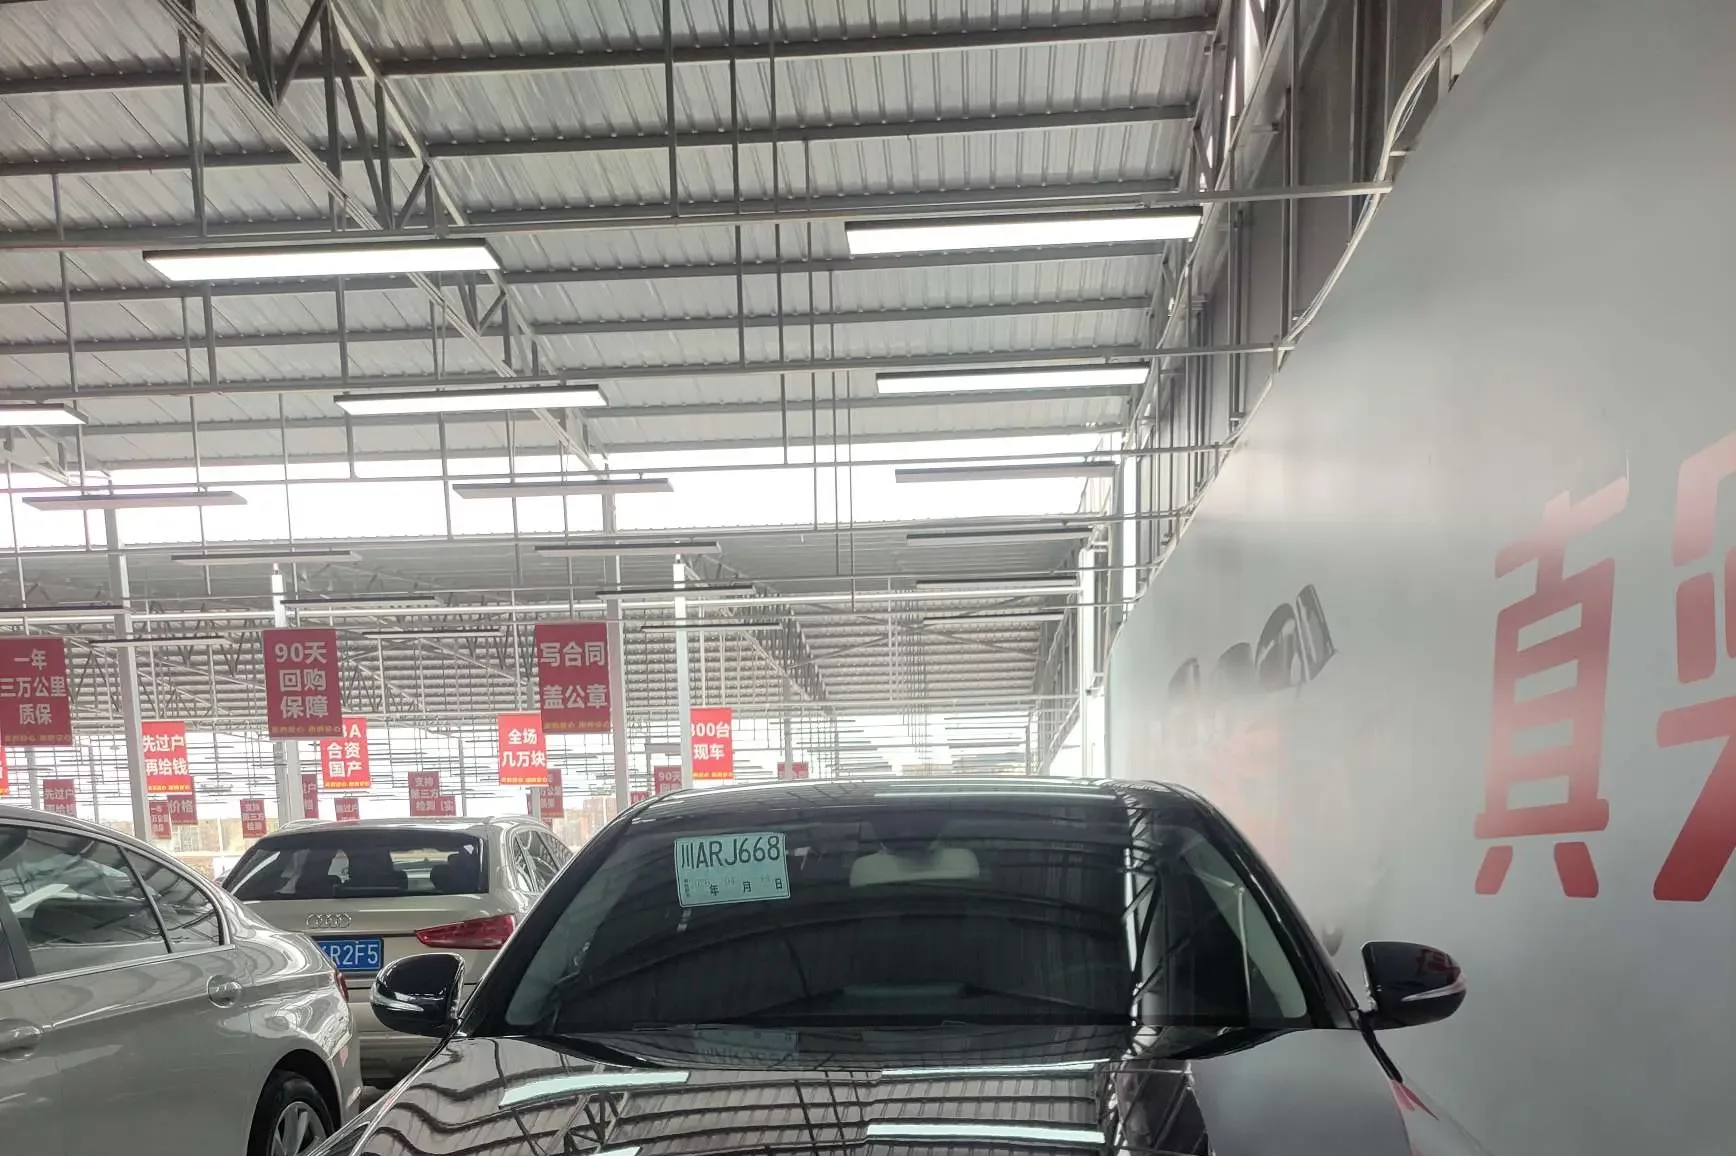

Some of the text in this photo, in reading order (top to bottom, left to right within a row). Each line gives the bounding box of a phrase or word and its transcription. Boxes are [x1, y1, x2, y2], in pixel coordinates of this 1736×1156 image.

[14, 648, 47, 670] 一年
[275, 641, 327, 664] 90天
[540, 641, 606, 667] 写合同
[0, 676, 67, 698] 三万公里
[279, 668, 326, 692] 回购
[280, 695, 329, 718] 保障
[543, 684, 608, 709] 盖公章
[19, 704, 52, 725] 质保
[143, 734, 185, 752] 先过户
[508, 728, 537, 745] 全场
[327, 742, 361, 759] 合资
[501, 750, 546, 768] 几万块
[693, 743, 725, 760] 现车
[145, 757, 190, 776] 再给钱
[328, 761, 362, 777] 国产
[681, 835, 781, 869] 川ARJ668
[322, 943, 379, 966] R2F5
